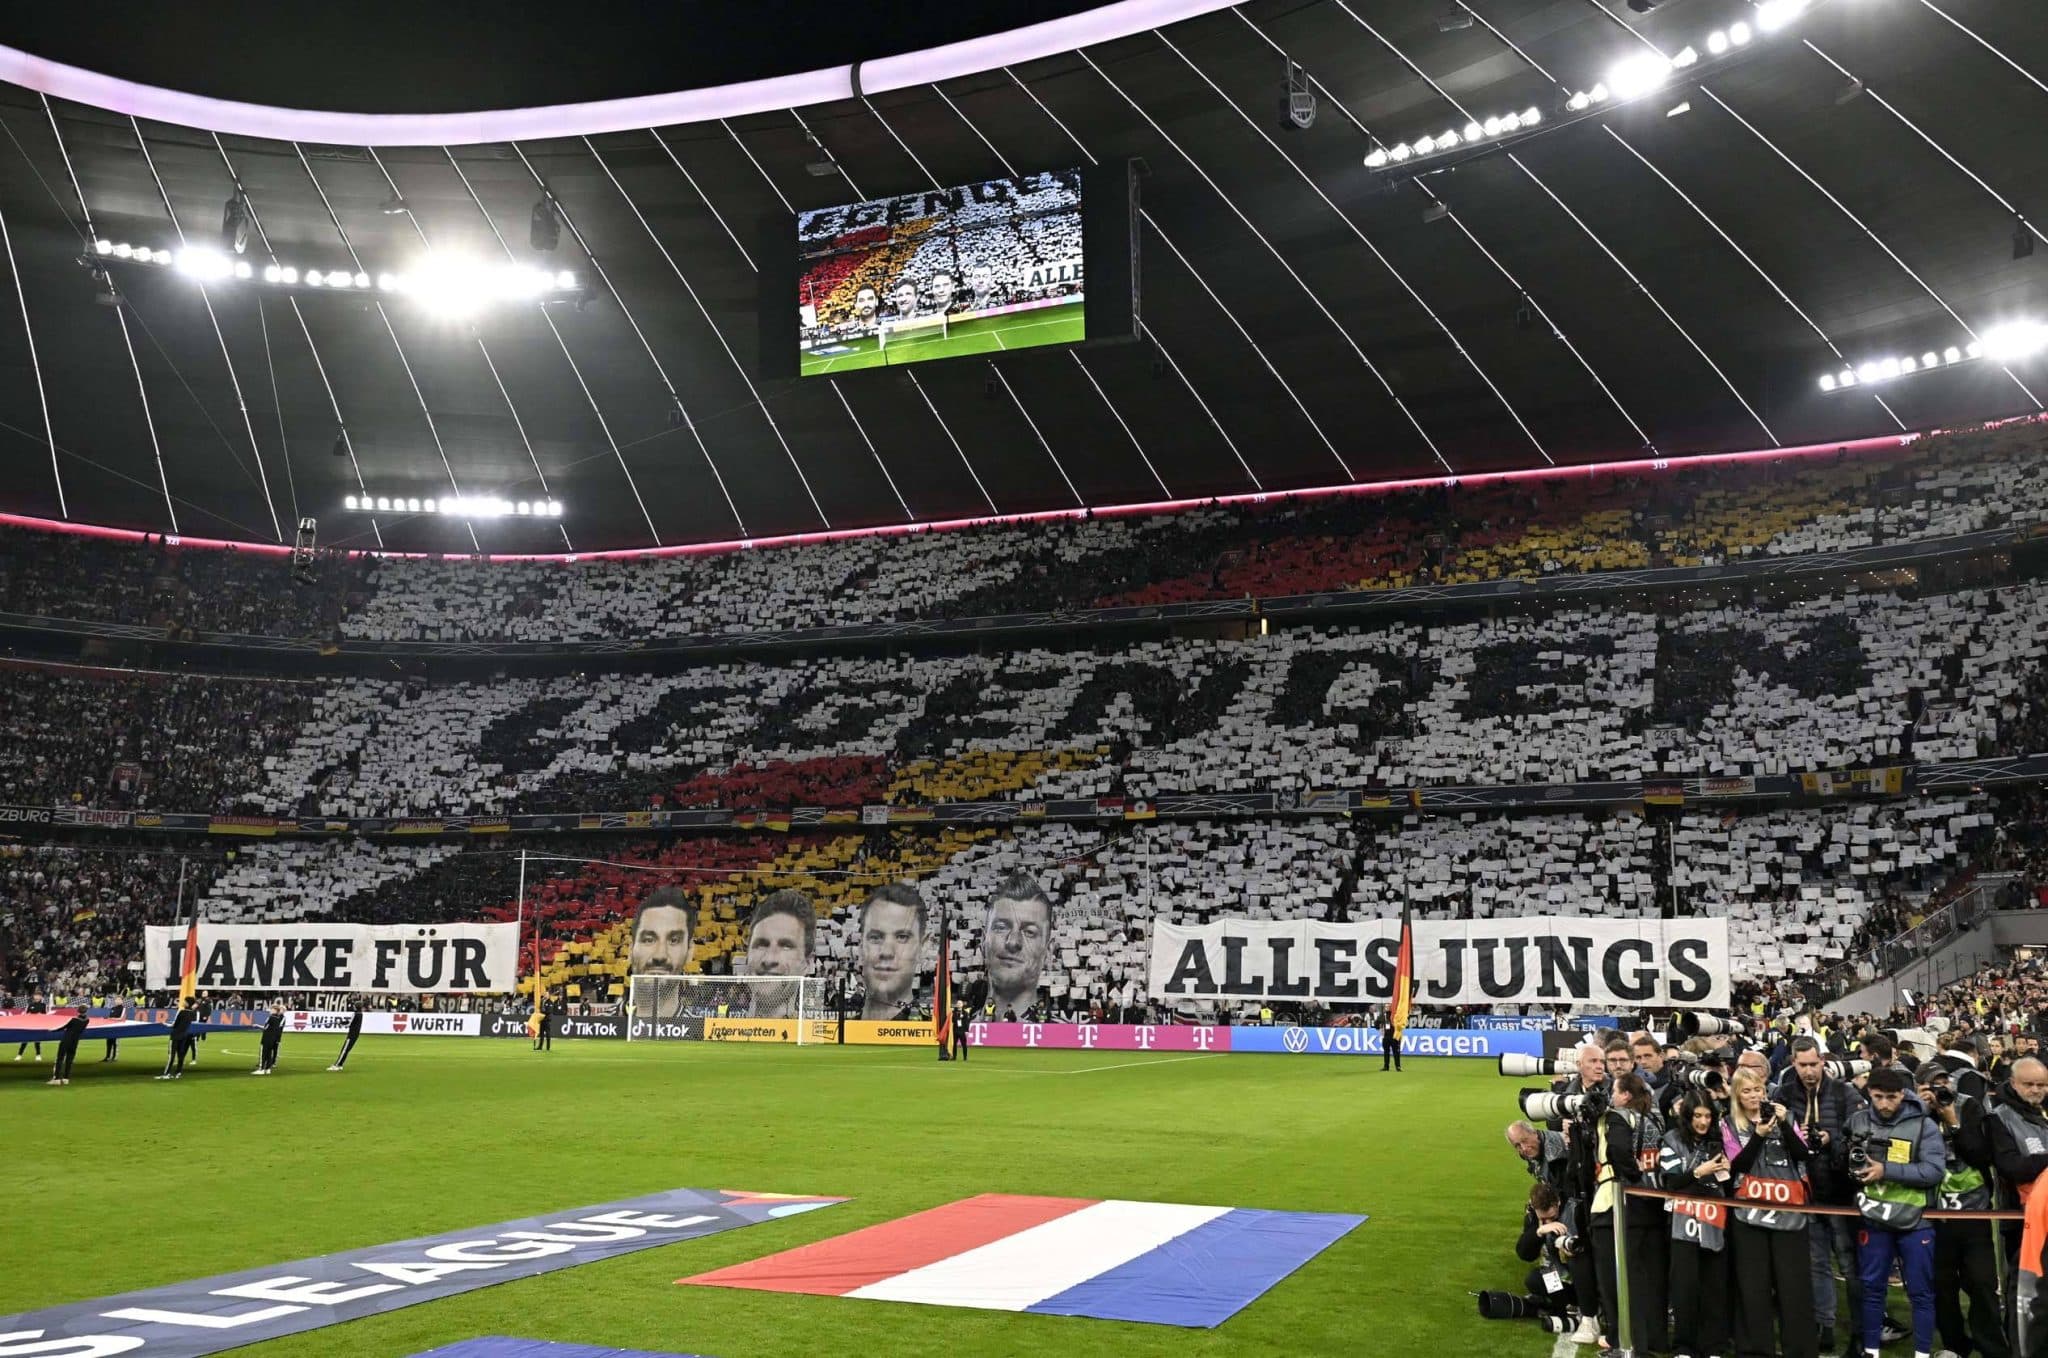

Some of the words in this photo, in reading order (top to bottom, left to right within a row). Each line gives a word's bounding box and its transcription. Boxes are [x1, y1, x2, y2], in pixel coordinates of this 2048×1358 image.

[165, 938, 353, 987] DANKE
[372, 928, 491, 989] FÜR
[1427, 937, 1710, 1002] JUNGS
[410, 1016, 463, 1032] WÜRTH
[575, 1022, 617, 1036] TikTok
[1489, 1022, 1520, 1031] LASST
[100, 1209, 722, 1329] LEAGUE
